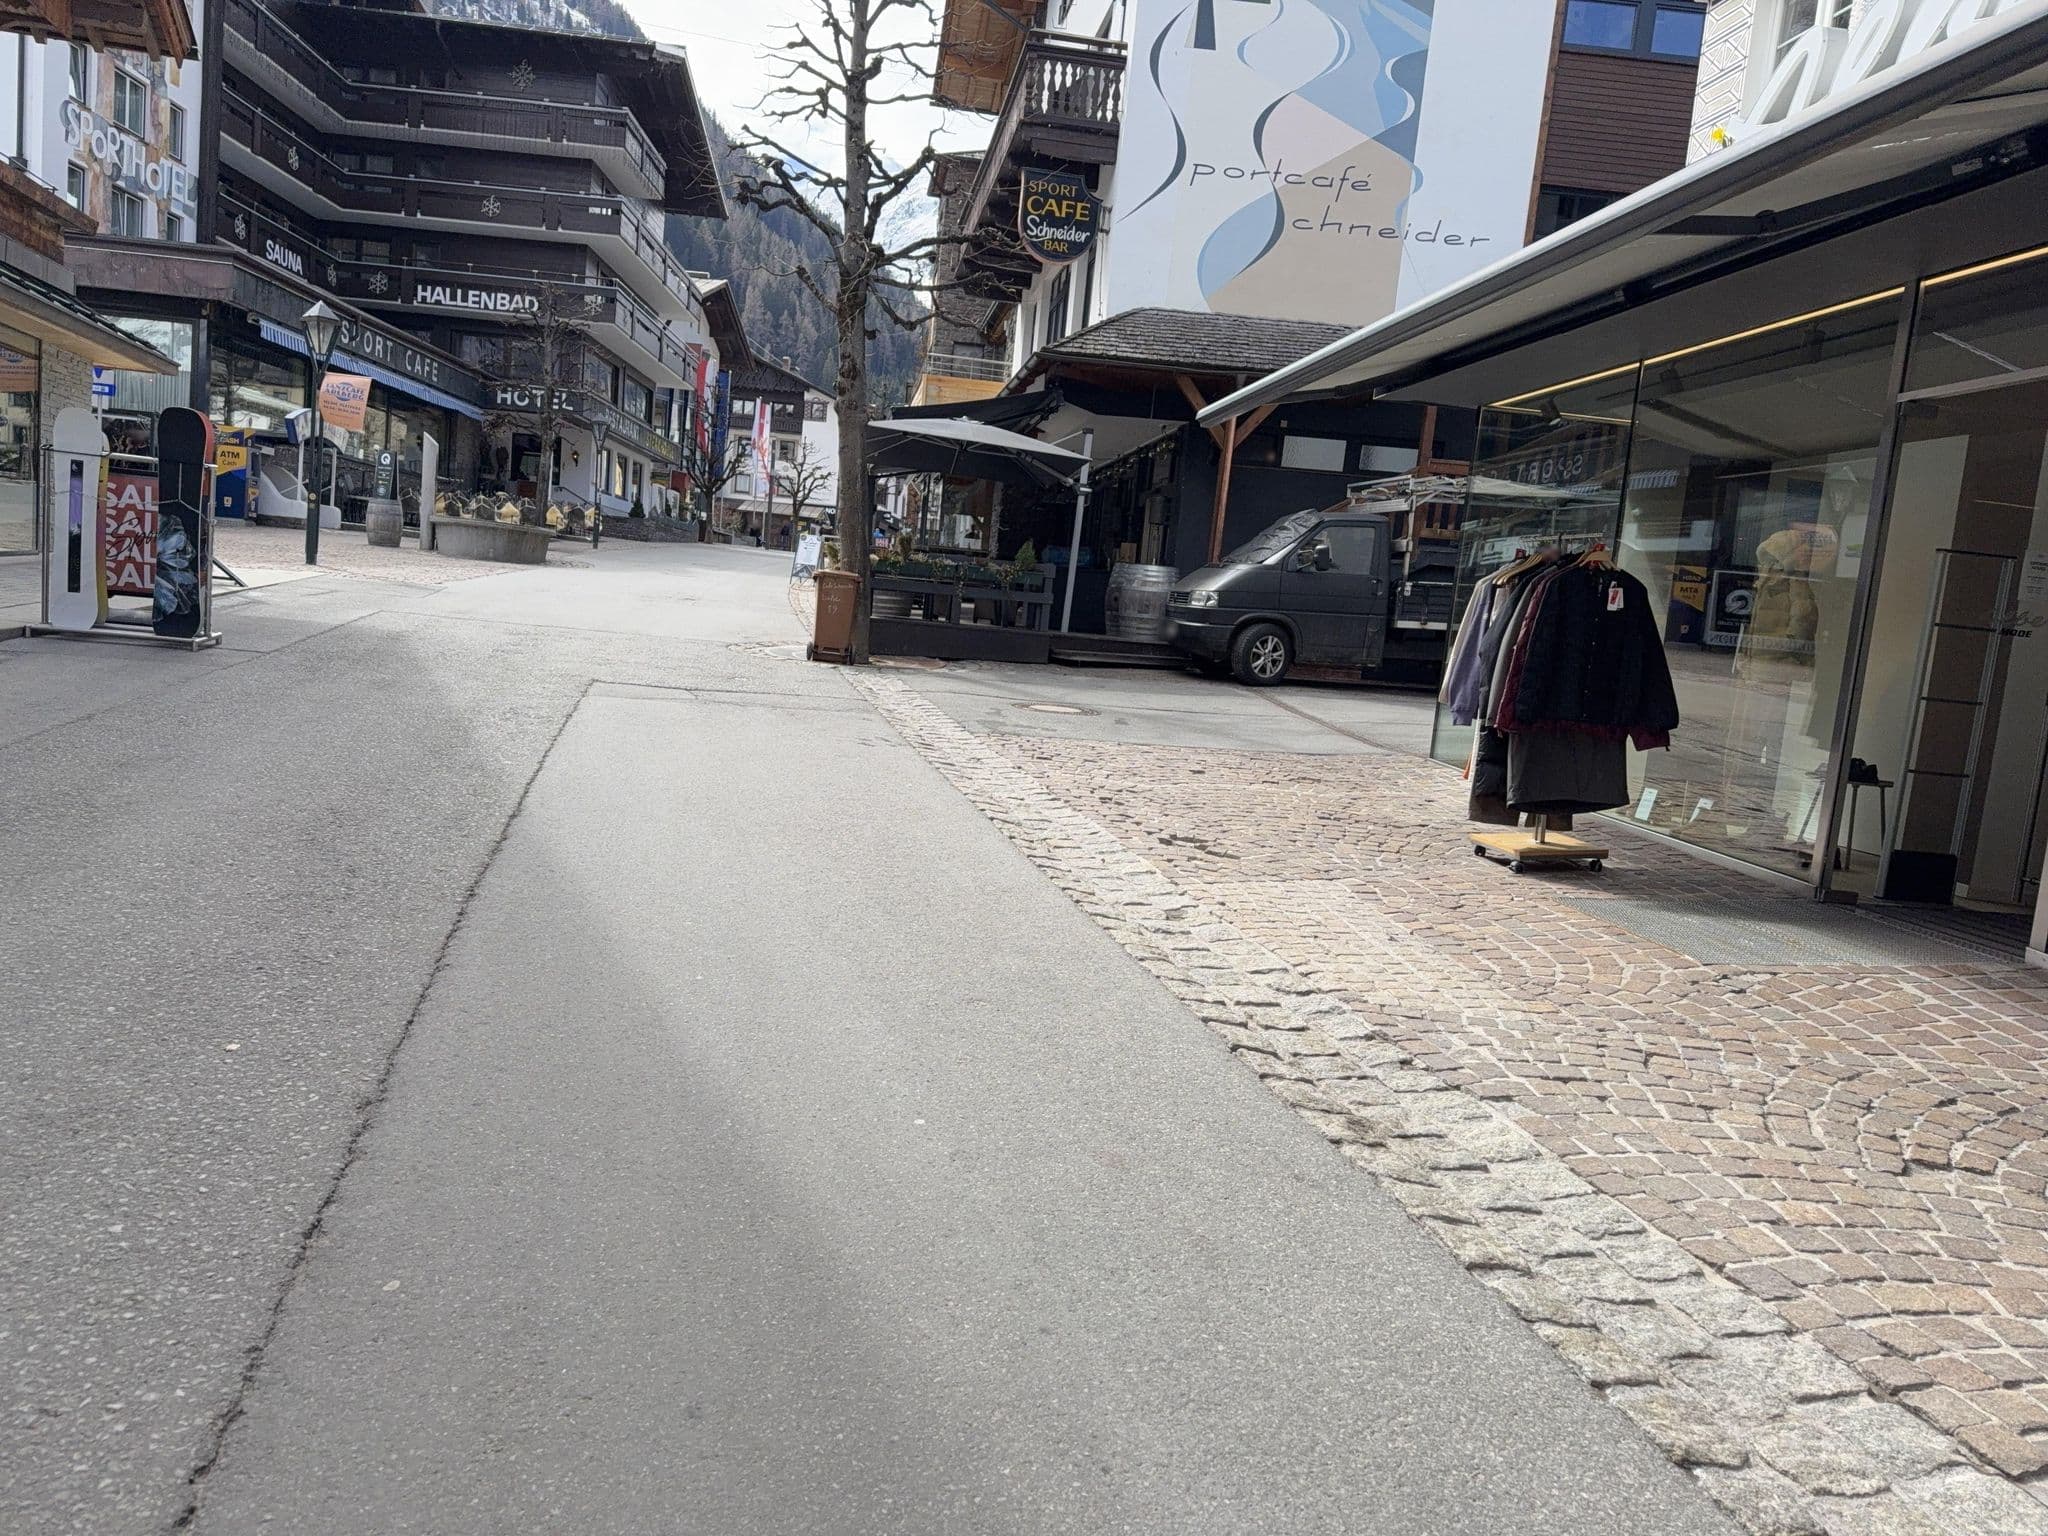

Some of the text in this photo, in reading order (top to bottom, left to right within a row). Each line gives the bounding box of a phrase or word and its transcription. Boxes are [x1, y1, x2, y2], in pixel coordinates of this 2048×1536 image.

[1028, 180, 1078, 198] SPORT
[1024, 215, 1090, 243] Schneider
[265, 239, 303, 276] SAUNA
[1044, 240, 1069, 253] BAR
[417, 284, 540, 313] HALLENBAD
[405, 350, 439, 383] CAFE
[497, 387, 574, 411] HOTEL
[219, 450, 240, 459] ATM
[106, 482, 159, 512] SAL
[106, 535, 157, 563] SAL
[106, 561, 157, 589] SAL
[2000, 628, 2032, 638] MODE
